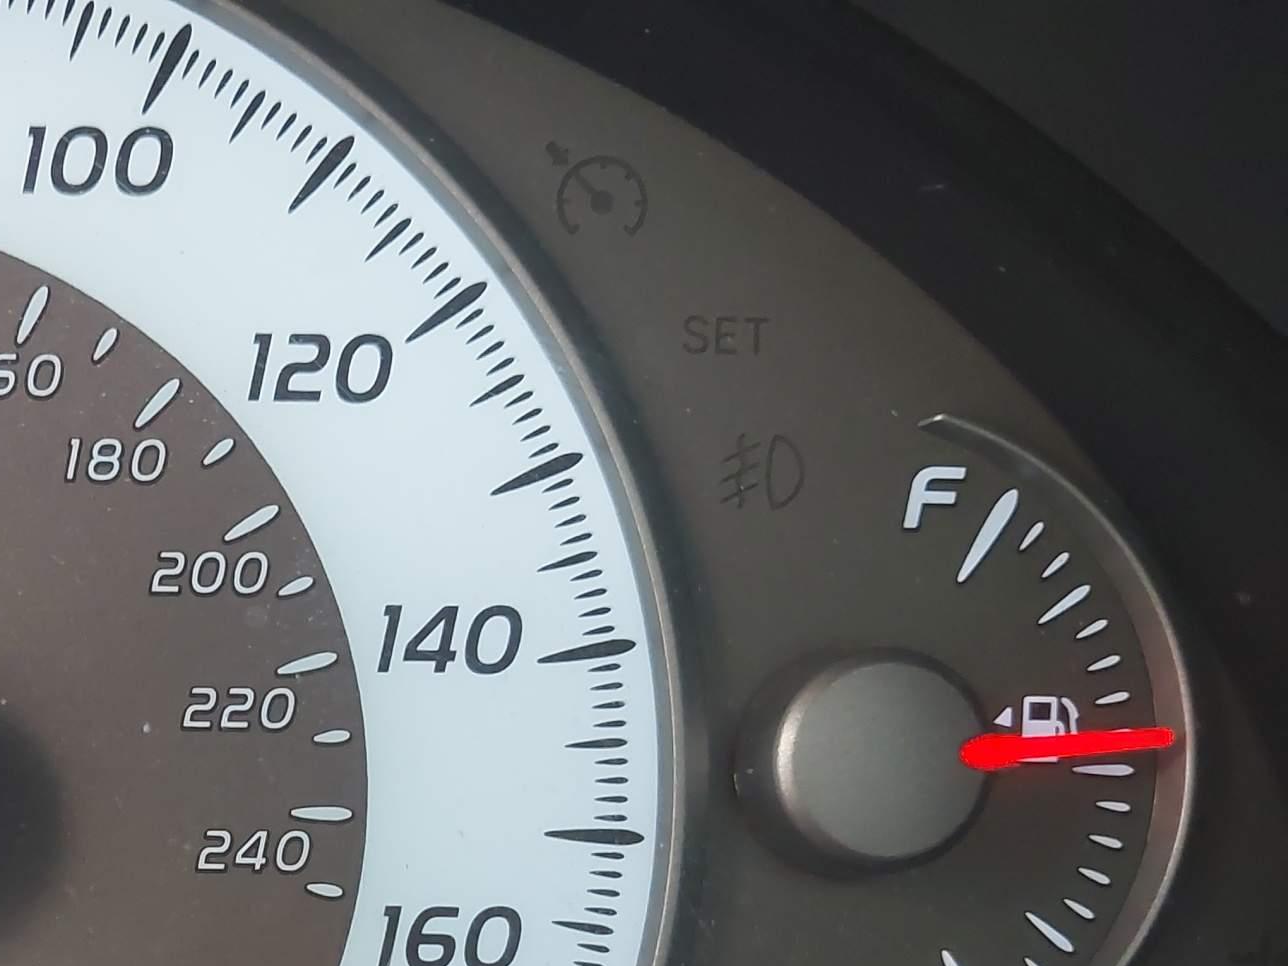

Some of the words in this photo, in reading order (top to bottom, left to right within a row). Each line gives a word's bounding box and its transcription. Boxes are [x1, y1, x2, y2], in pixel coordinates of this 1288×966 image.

[21, 125, 175, 196] 100
[681, 315, 770, 357] SET
[247, 332, 394, 405] 120
[65, 437, 168, 485] 180
[902, 465, 968, 529] F
[150, 550, 270, 595] 200
[376, 604, 524, 675] 140
[181, 686, 297, 731] 220
[195, 829, 312, 873] 240
